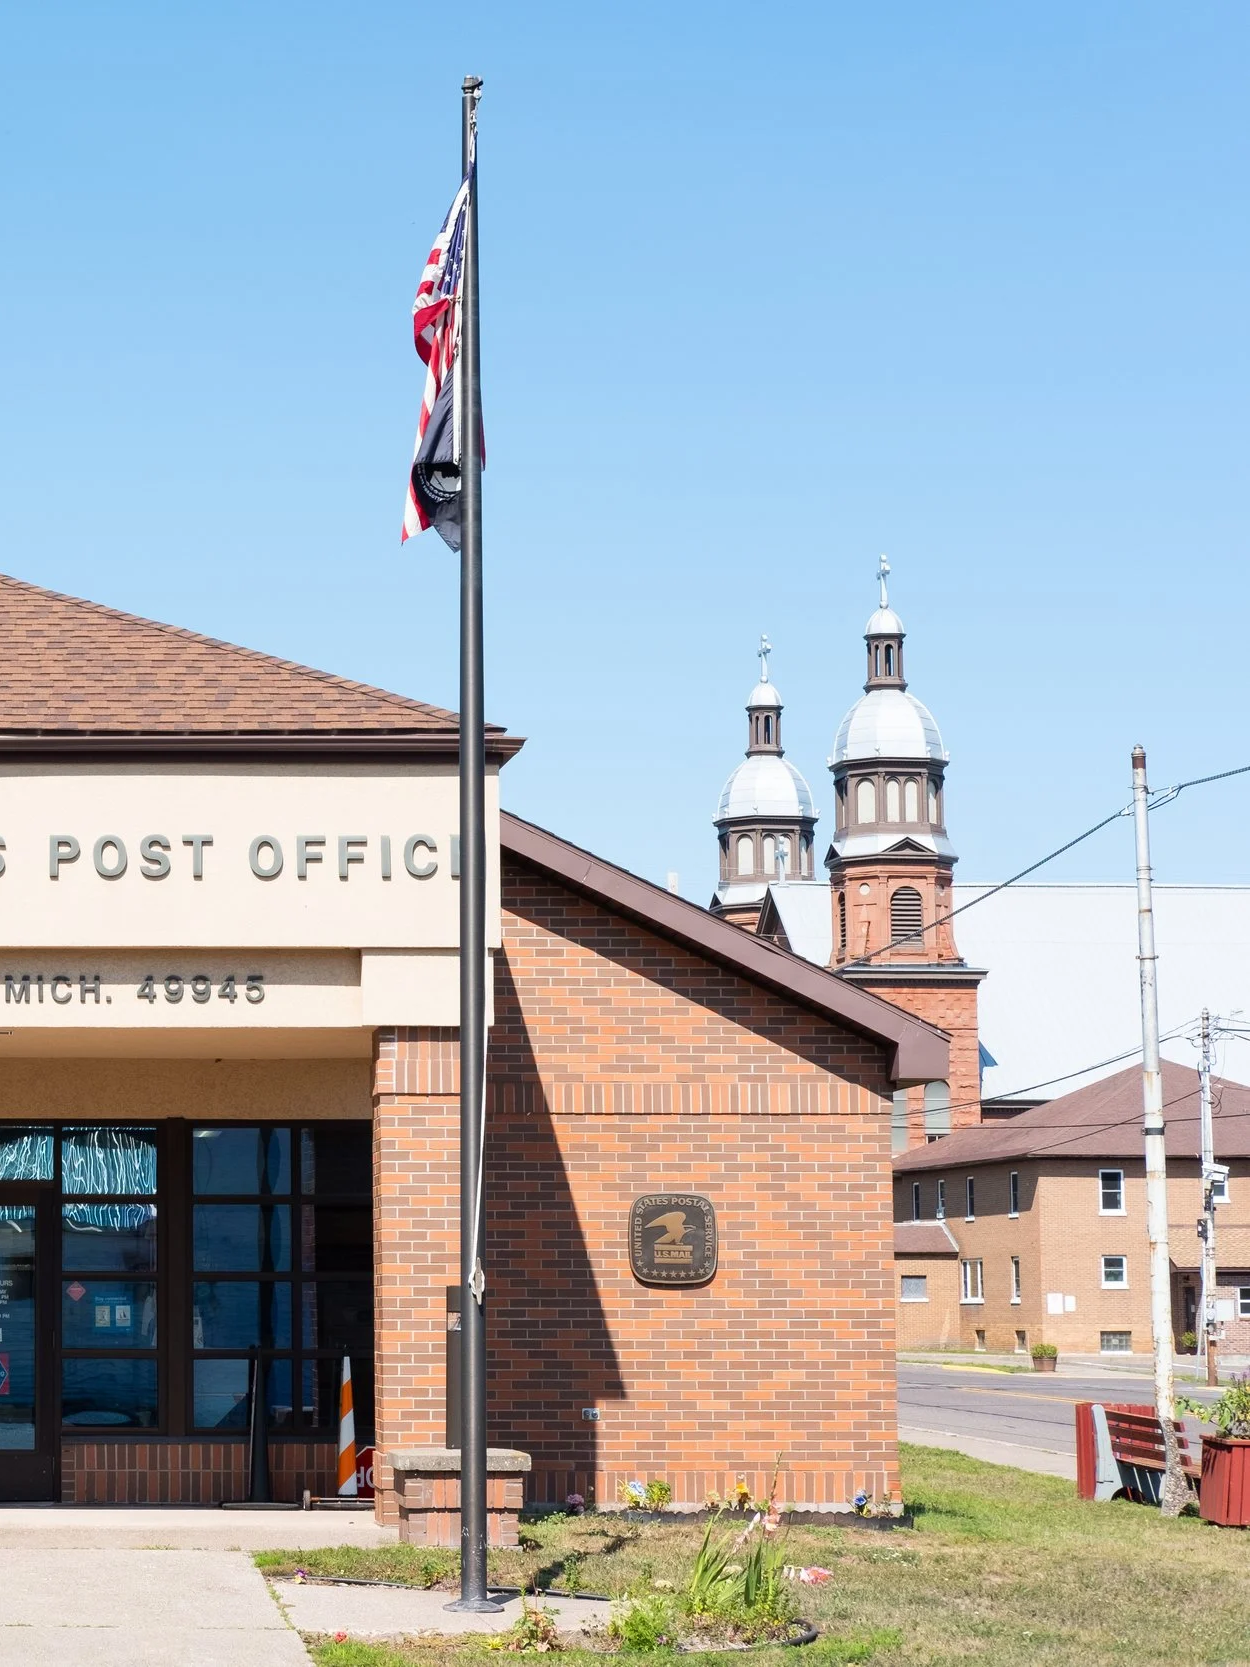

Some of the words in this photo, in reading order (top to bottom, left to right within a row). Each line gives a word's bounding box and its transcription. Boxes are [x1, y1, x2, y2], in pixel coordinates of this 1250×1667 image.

[49, 833, 214, 880] POST
[4, 974, 112, 1004] MICH.
[136, 974, 266, 1004] 49945
[636, 1197, 669, 1215] STATES
[671, 1197, 710, 1214] POSTAL
[634, 1217, 643, 1257] UNITED
[704, 1215, 713, 1257] SERVICE
